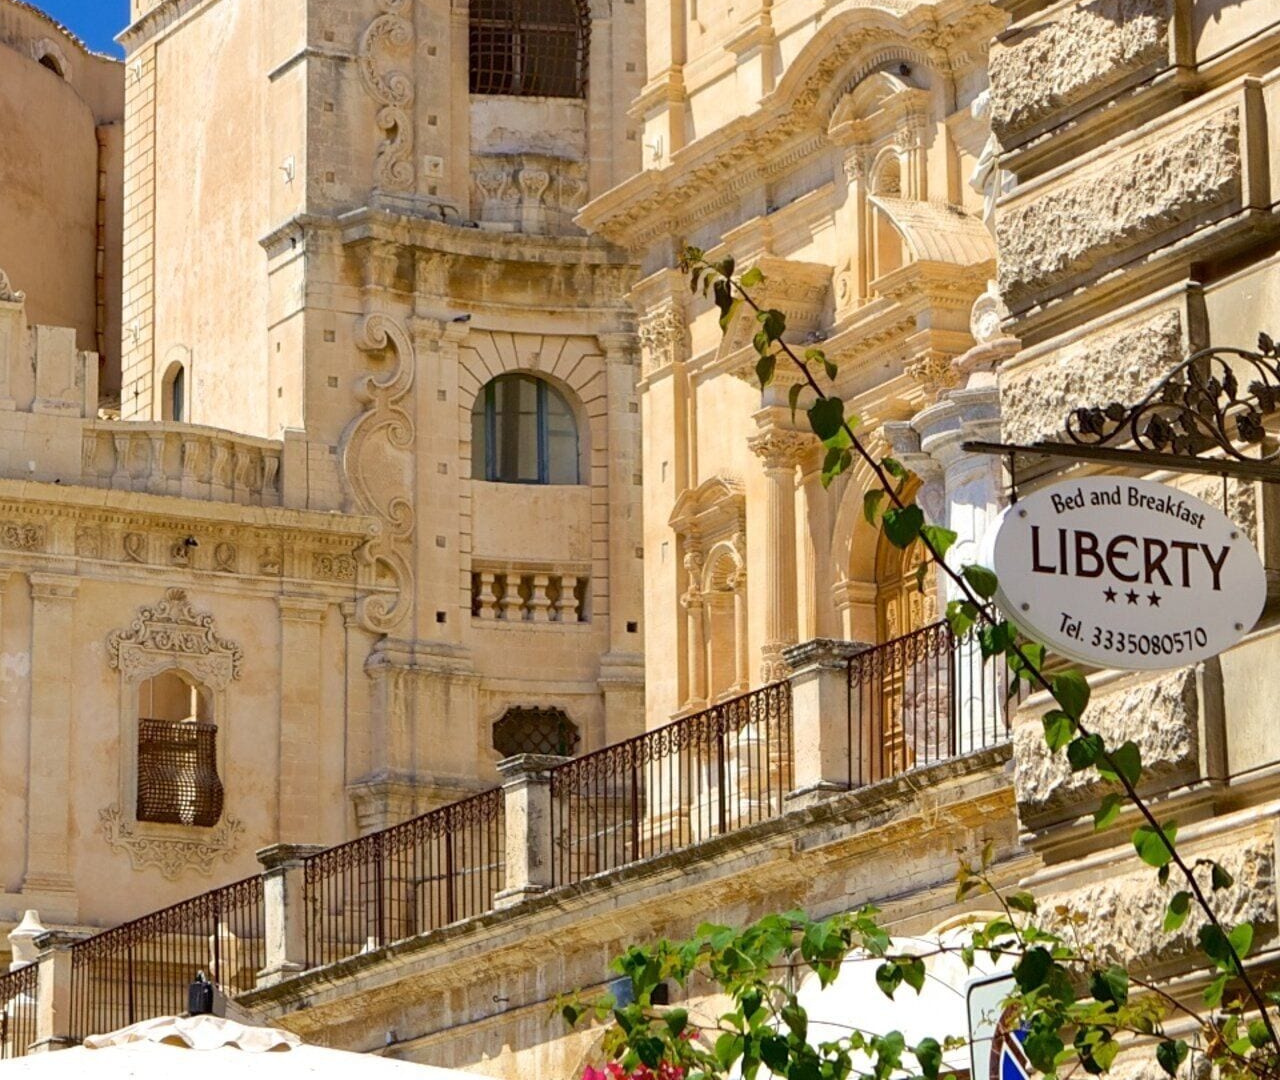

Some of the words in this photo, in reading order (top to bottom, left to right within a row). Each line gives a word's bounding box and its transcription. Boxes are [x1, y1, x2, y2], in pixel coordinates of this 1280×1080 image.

[1050, 487, 1085, 514] Bed
[1090, 485, 1121, 506] and
[1128, 486, 1205, 529] Breakfast
[1031, 525, 1230, 591] LIBERTY
[1060, 612, 1084, 642] Tel.
[1091, 626, 1208, 655] 3335080570
